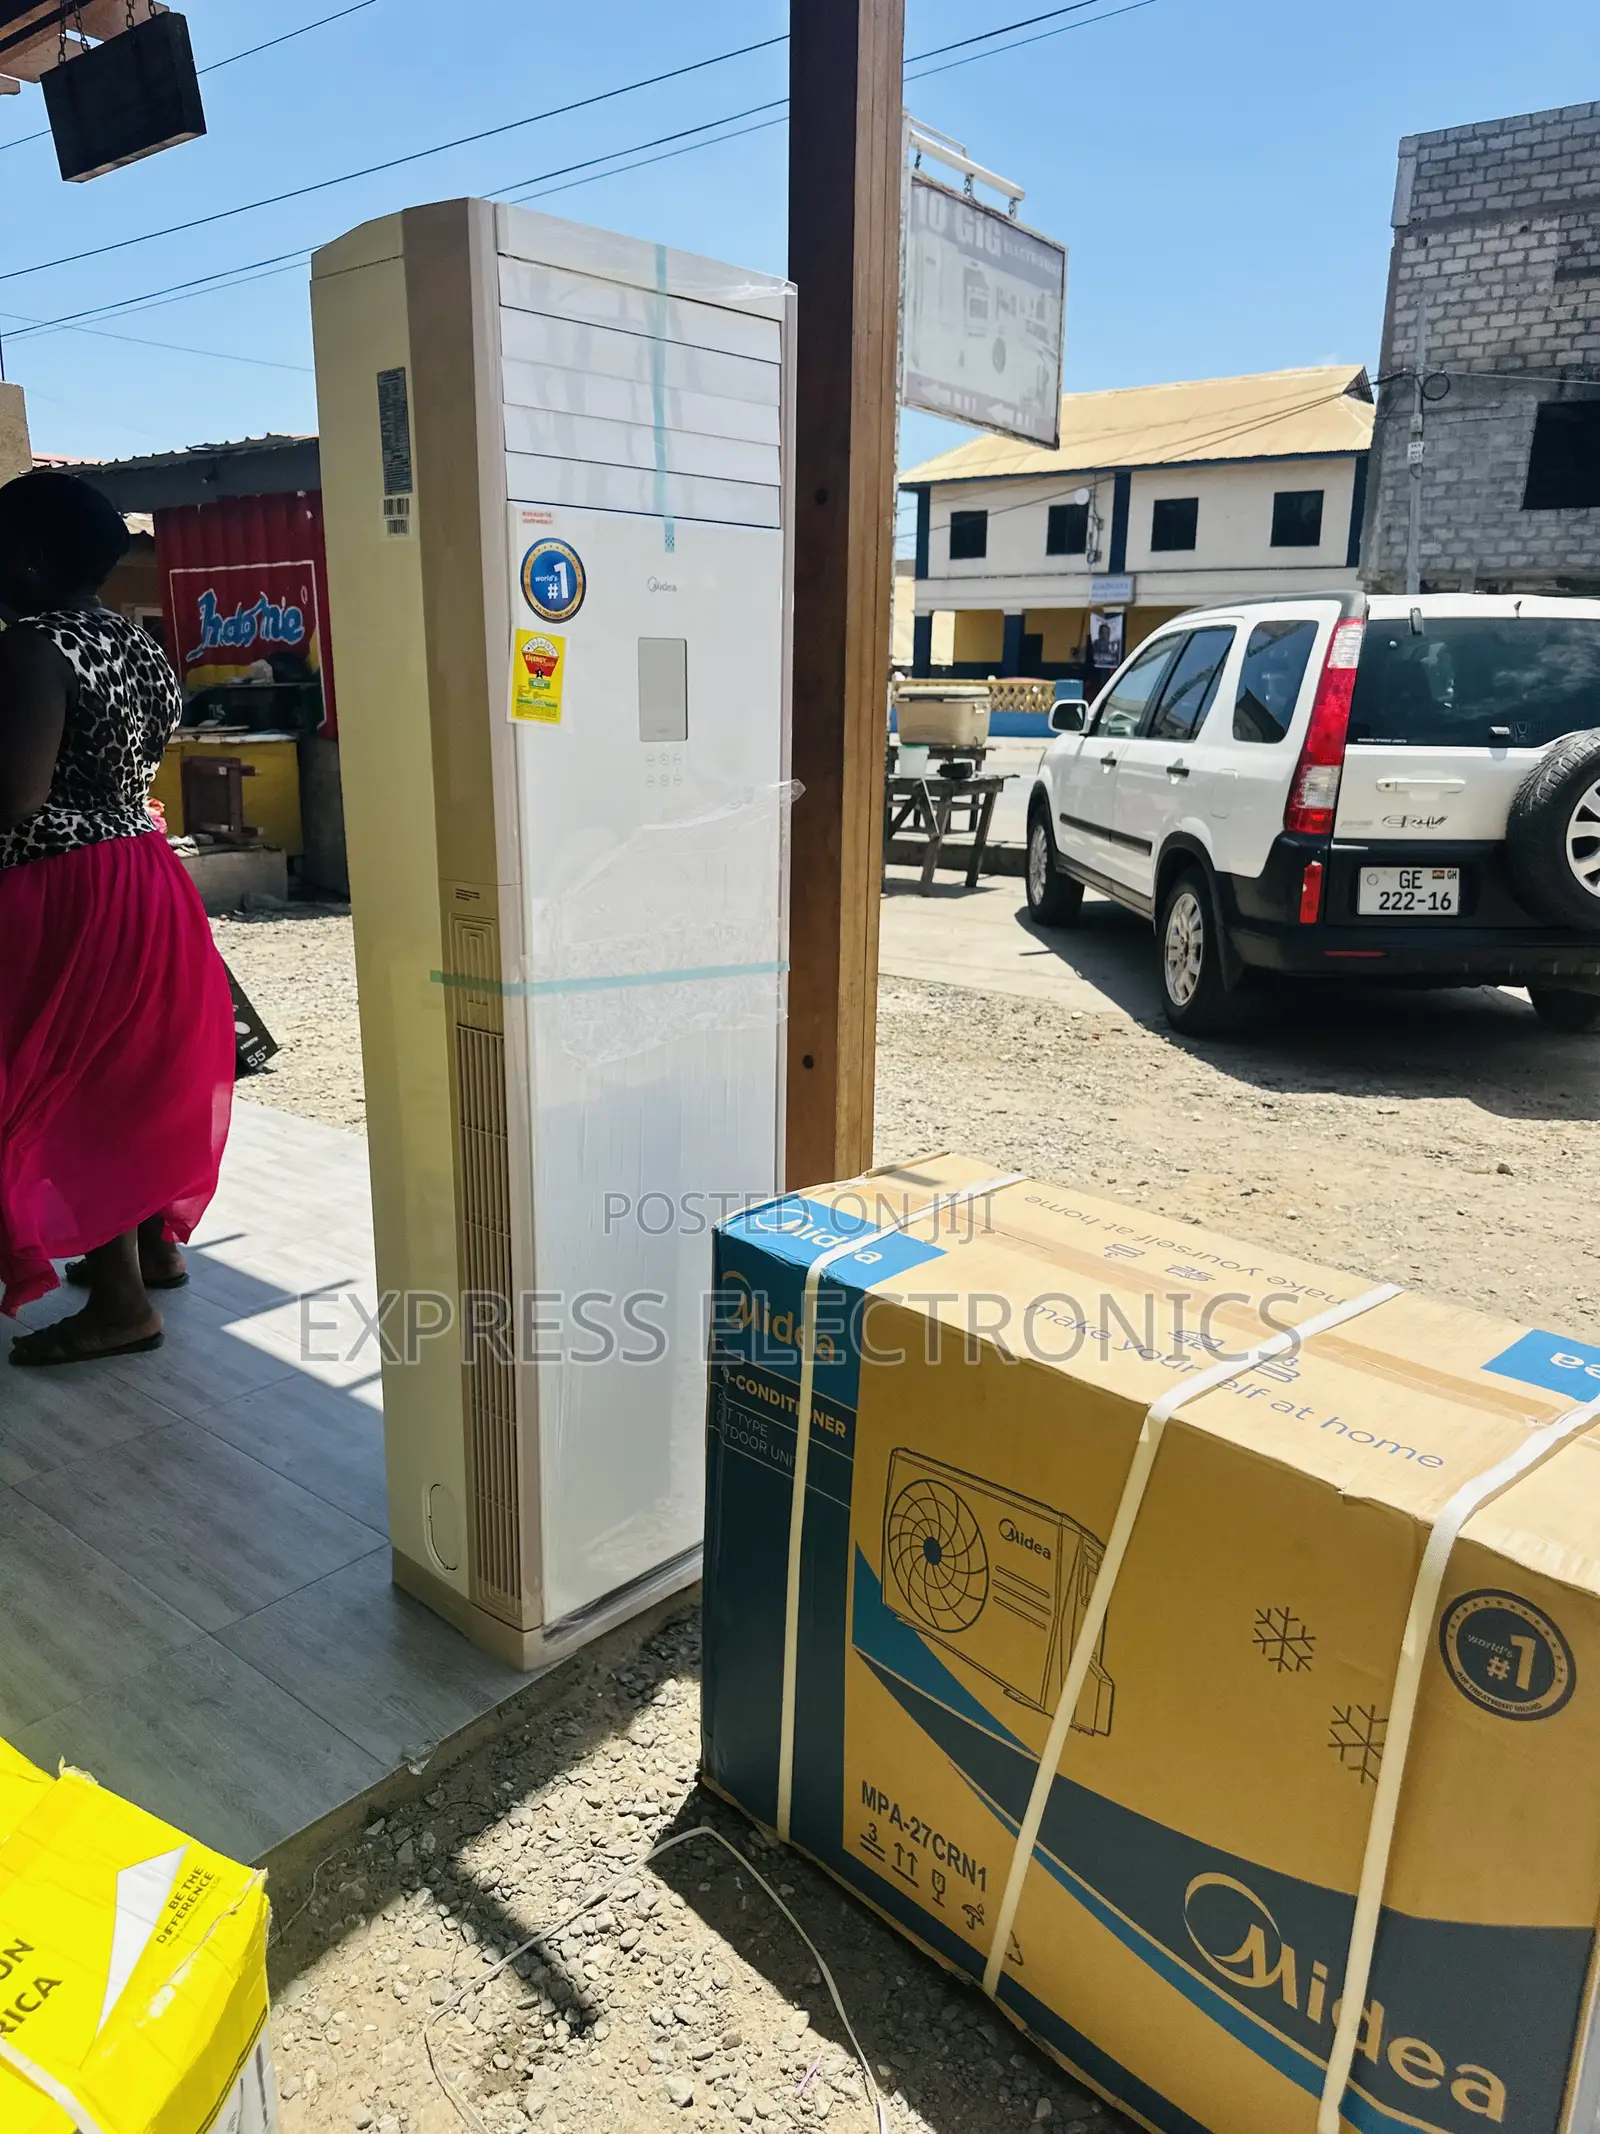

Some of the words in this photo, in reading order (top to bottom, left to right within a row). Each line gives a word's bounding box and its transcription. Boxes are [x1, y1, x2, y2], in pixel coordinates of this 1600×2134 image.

[647, 576, 677, 593] Midea
[1399, 870, 1423, 889] GE
[1447, 870, 1457, 880] GH
[1379, 892, 1452, 910] 222-16
[1024, 1194, 1099, 1227] home
[756, 1208, 883, 1265] Mida
[1103, 1222, 1135, 1235] at
[1132, 1234, 1264, 1276] yourself
[1024, 1302, 1112, 1341] make
[1112, 1338, 1271, 1399] yourelf
[1270, 1400, 1315, 1421] at
[1320, 1416, 1444, 1469] home
[737, 1410, 769, 1438] TYPE
[998, 1518, 1051, 1560] Midea
[1466, 1633, 1513, 1658] world's
[861, 1779, 987, 1893] MPA-27CRN1
[168, 1892, 185, 1910] BE
[181, 1866, 204, 1890] THE
[1182, 1872, 1506, 2123] Midea
